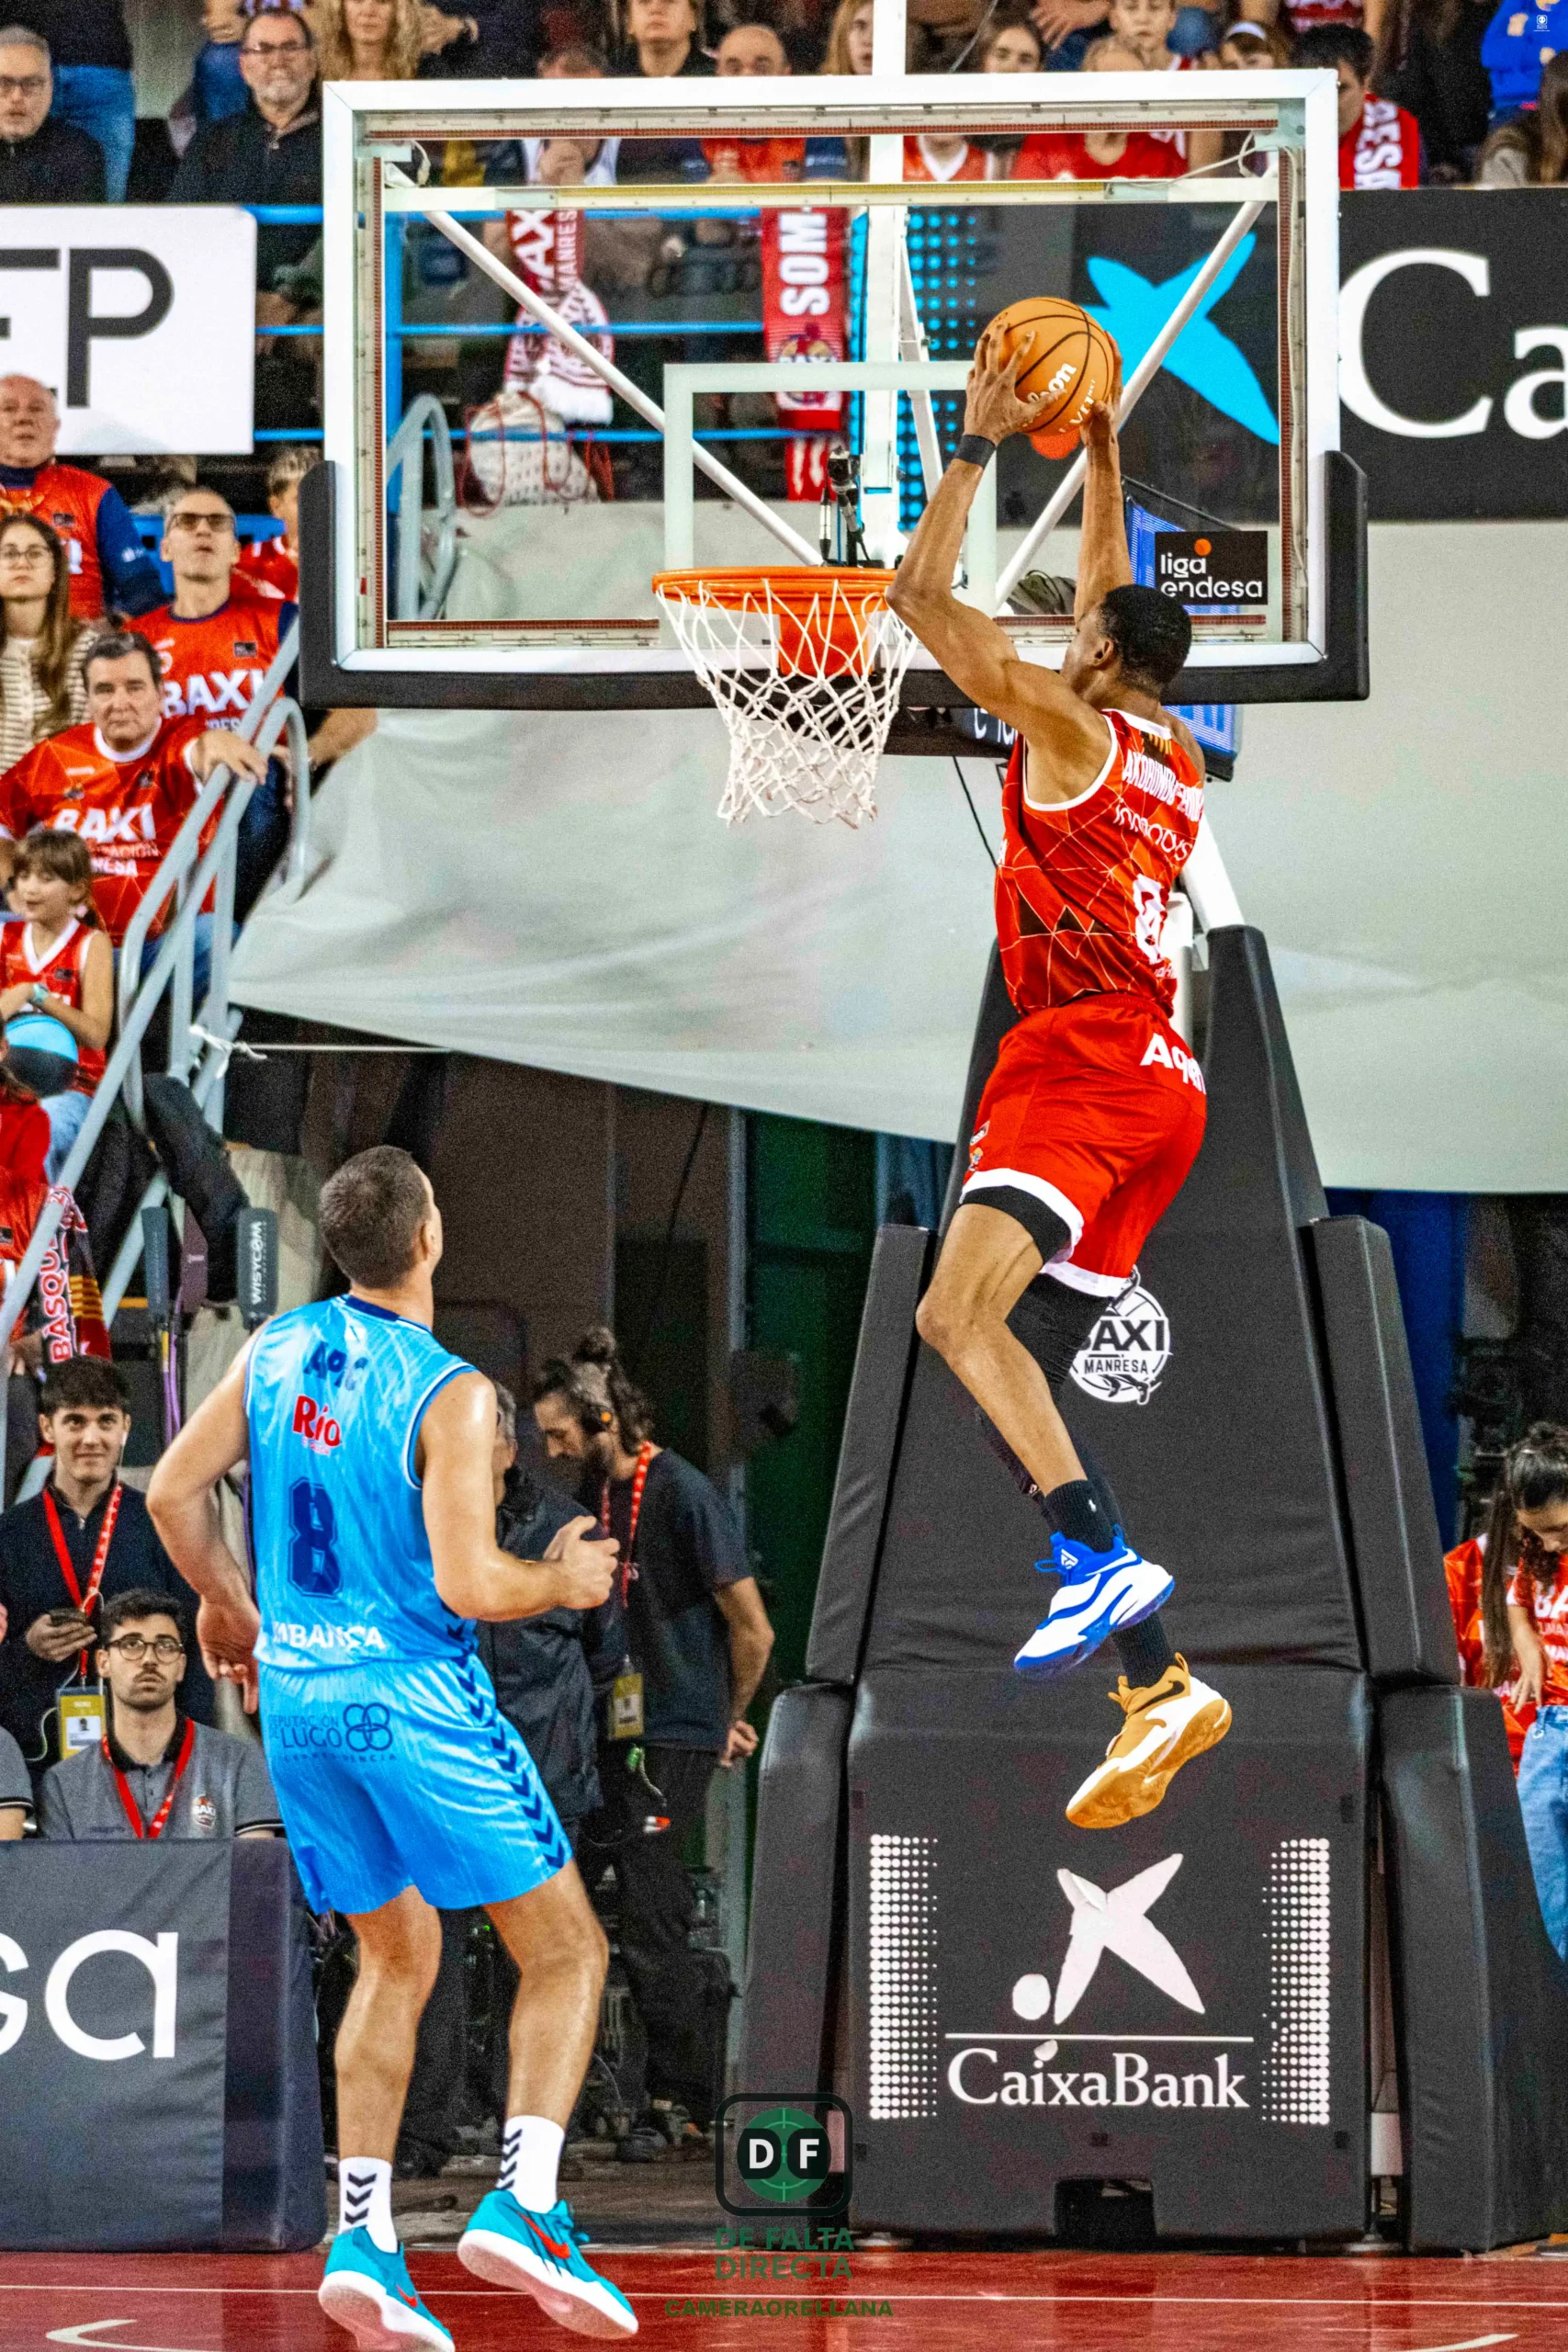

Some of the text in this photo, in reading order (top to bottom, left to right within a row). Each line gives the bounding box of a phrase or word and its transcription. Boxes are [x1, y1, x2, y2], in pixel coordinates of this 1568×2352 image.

[1160, 552, 1206, 578] liga
[1160, 576, 1262, 597] endesa
[251, 1220, 263, 1305] WISYCOM
[1078, 1319, 1165, 1351] AXI
[1084, 1359, 1148, 1374] MANRESA
[288, 1476, 344, 1600] 8
[280, 1727, 343, 1748] LUGO
[948, 2048, 1250, 2108] CaixaBank
